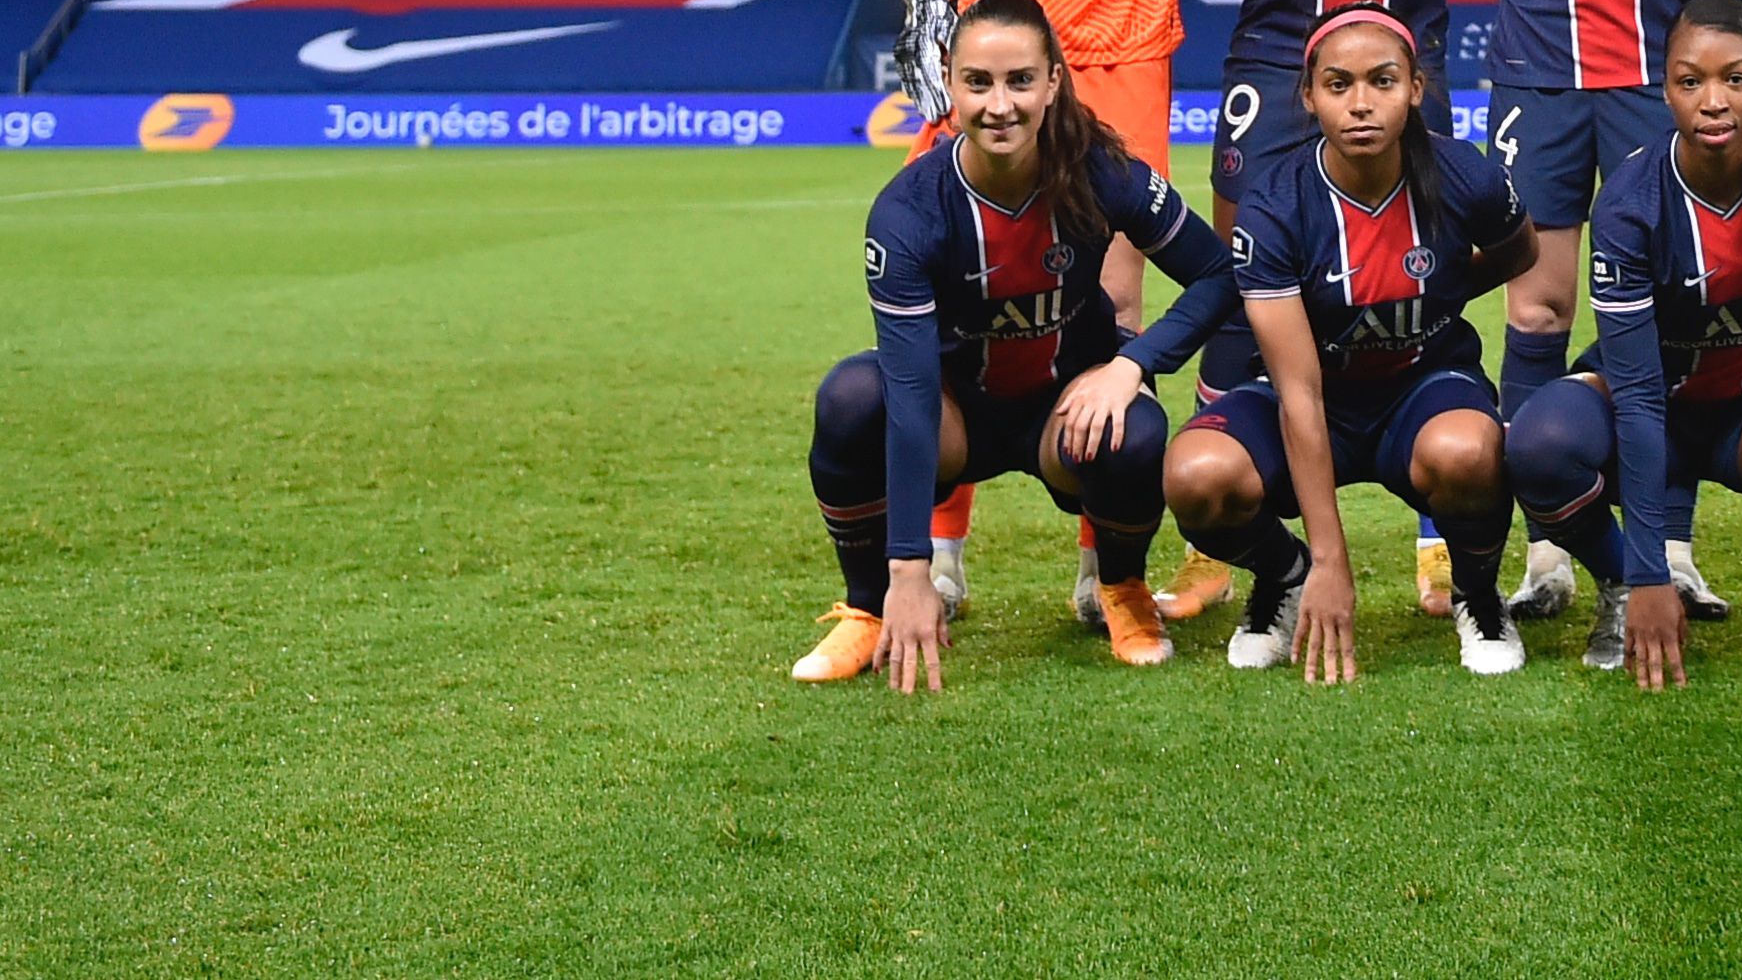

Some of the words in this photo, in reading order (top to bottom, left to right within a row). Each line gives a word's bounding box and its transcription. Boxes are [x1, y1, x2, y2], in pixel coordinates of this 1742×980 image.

[0, 111, 57, 147] ge
[325, 102, 509, 139] Journées
[518, 103, 571, 138] de
[581, 103, 784, 145] l'arbitrage
[1224, 83, 1260, 142] 9
[1451, 106, 1488, 140] ge
[1495, 106, 1522, 167] 4
[1003, 331, 1033, 340] LIVE
